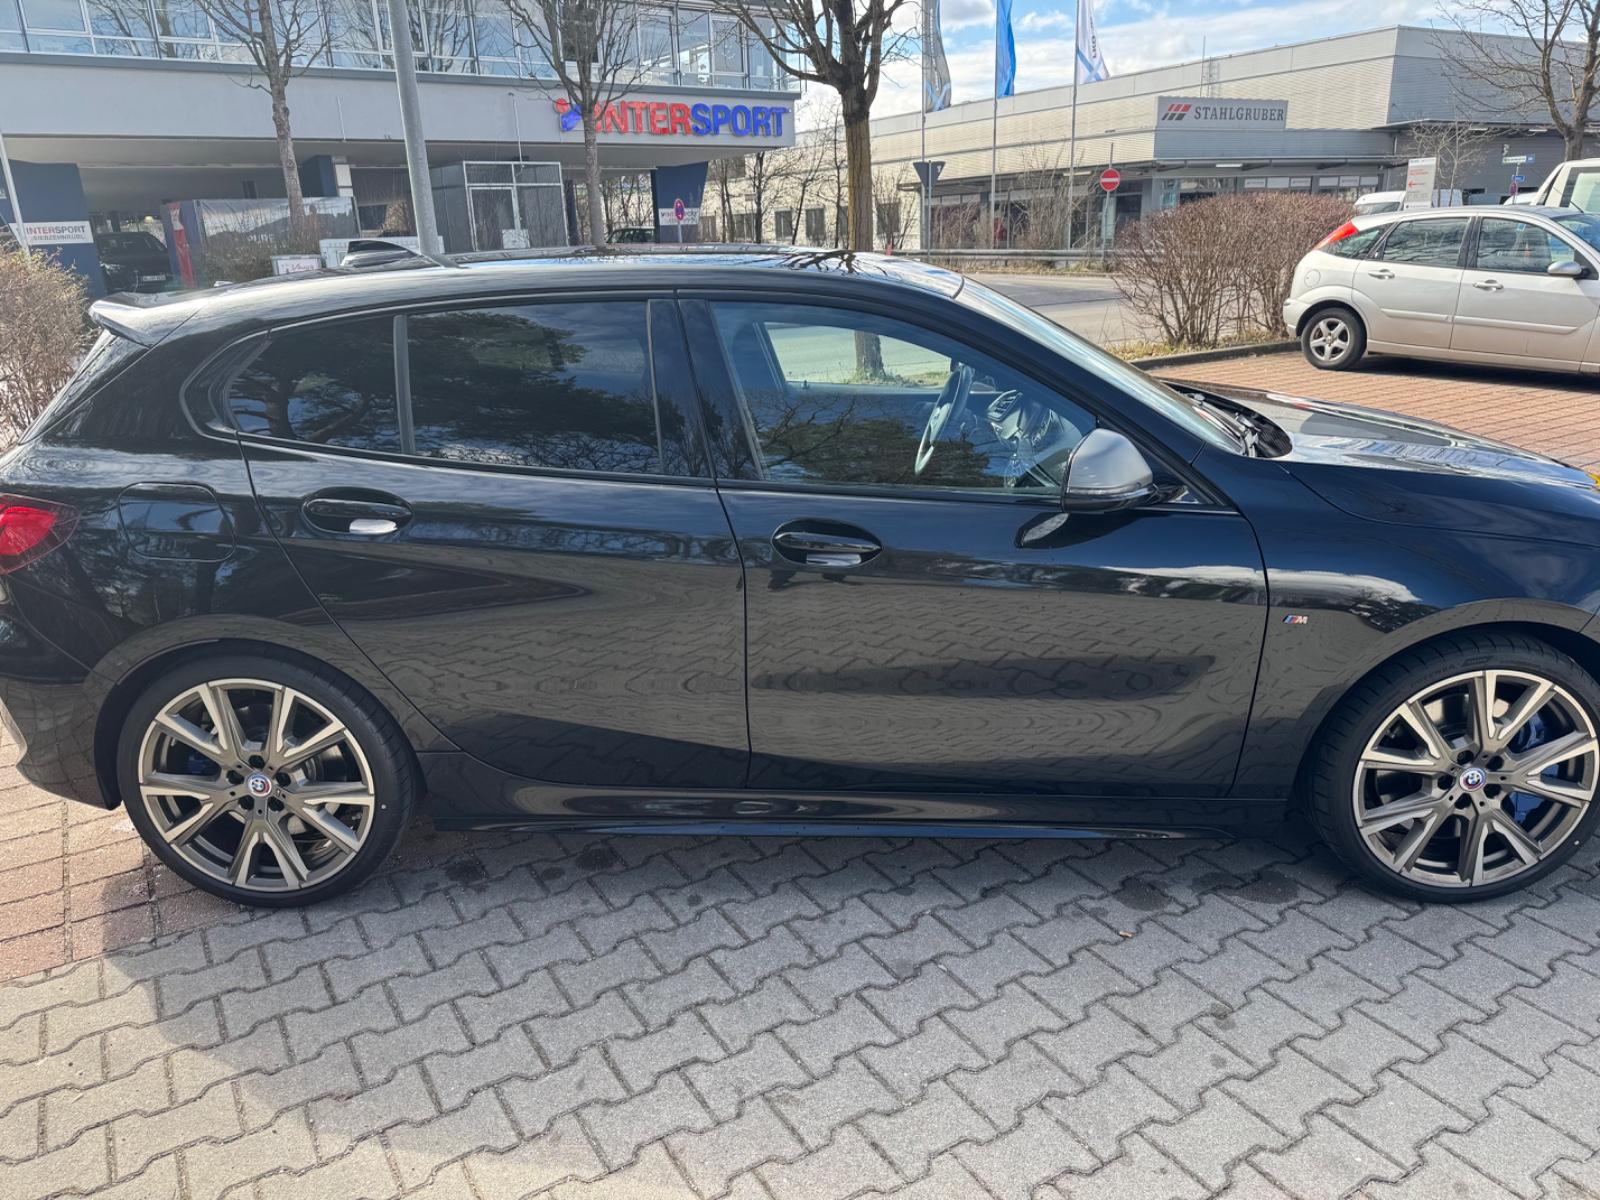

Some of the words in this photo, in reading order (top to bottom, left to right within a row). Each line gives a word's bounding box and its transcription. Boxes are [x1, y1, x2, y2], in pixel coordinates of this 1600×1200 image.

[594, 100, 788, 137] INTERSPORT
[1194, 106, 1284, 121] STAHLGRUBER
[26, 225, 86, 235] INTERSPORT
